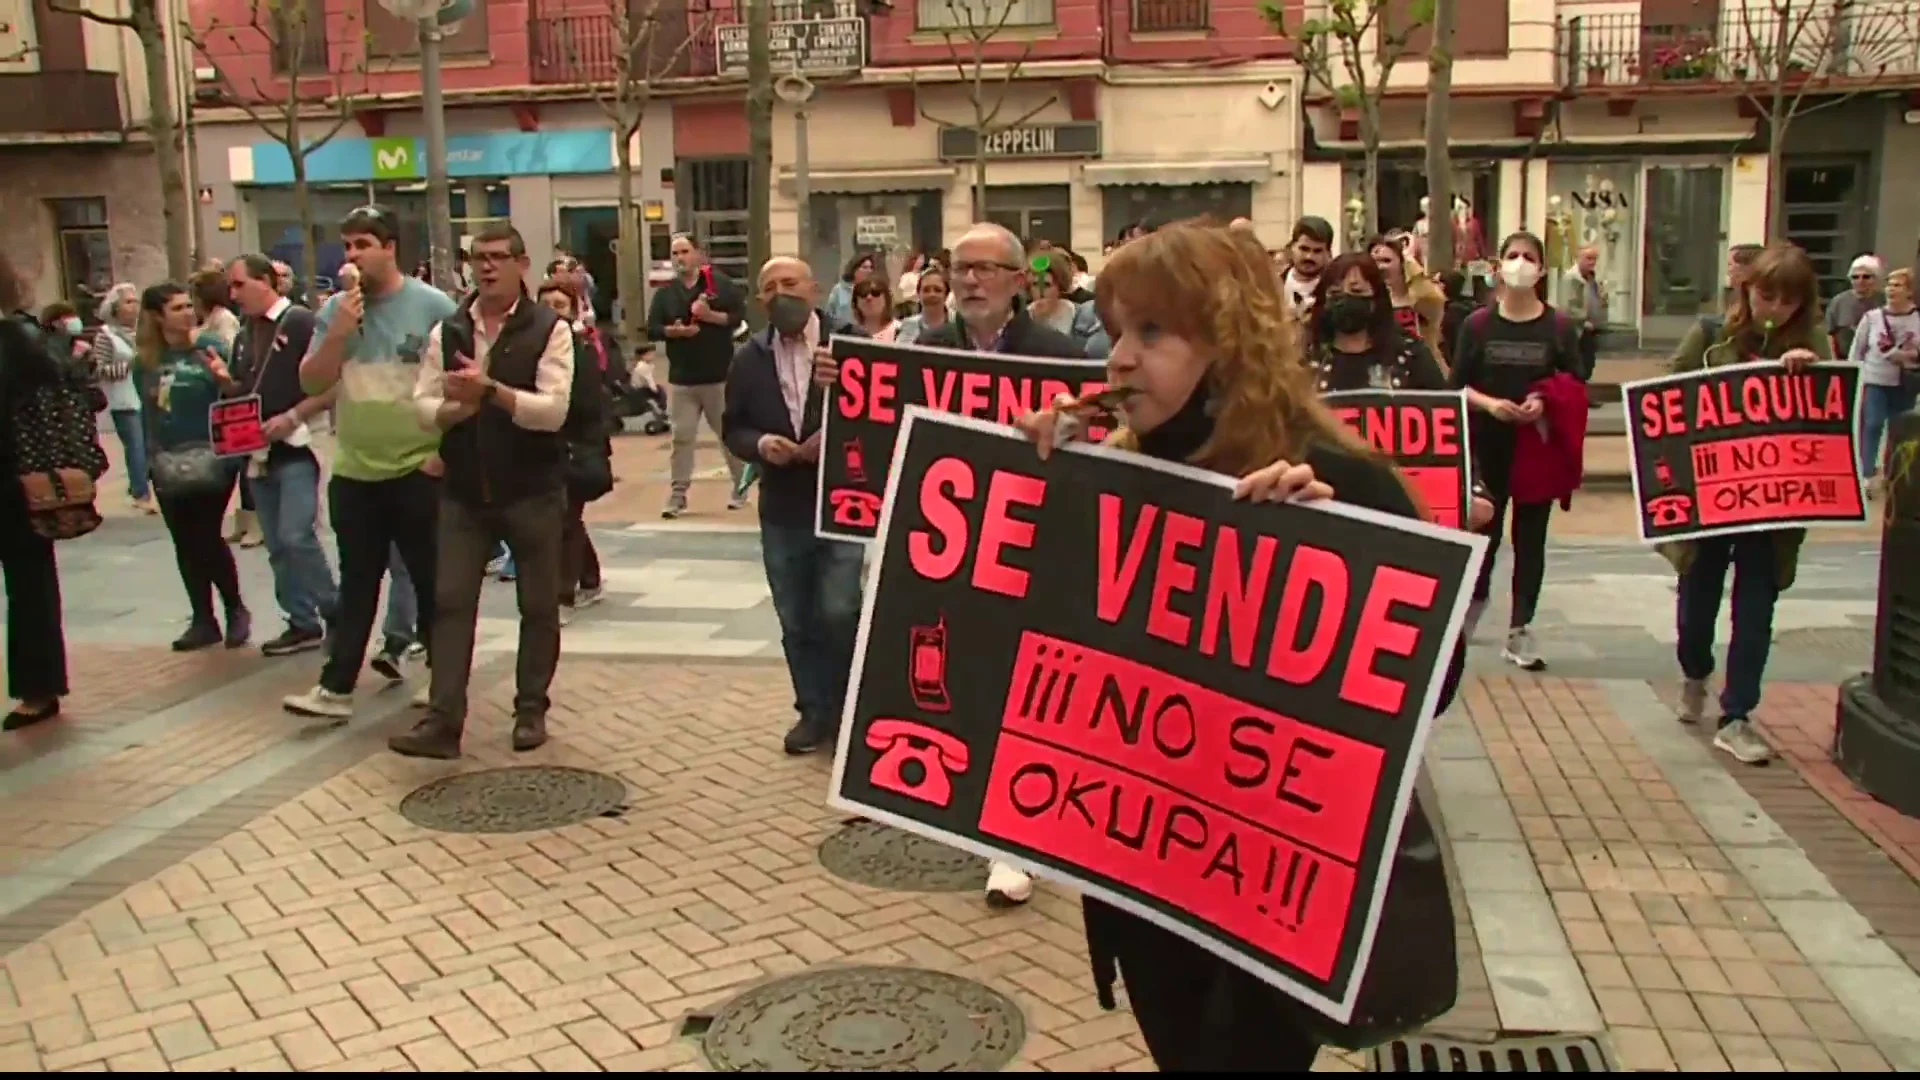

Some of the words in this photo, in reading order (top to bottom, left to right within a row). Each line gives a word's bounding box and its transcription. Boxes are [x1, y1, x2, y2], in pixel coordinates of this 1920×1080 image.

[985, 127, 1055, 154] ZEPPELIN
[839, 357, 898, 424] SE
[1641, 388, 1687, 437] SE
[1696, 375, 1844, 429] ALQUILA
[1732, 441, 1780, 472] NO
[1792, 439, 1825, 466] SE
[908, 457, 1047, 598] SE
[1097, 493, 1439, 715] VENDE
[1089, 675, 1196, 759] NO
[1223, 716, 1336, 813] SE
